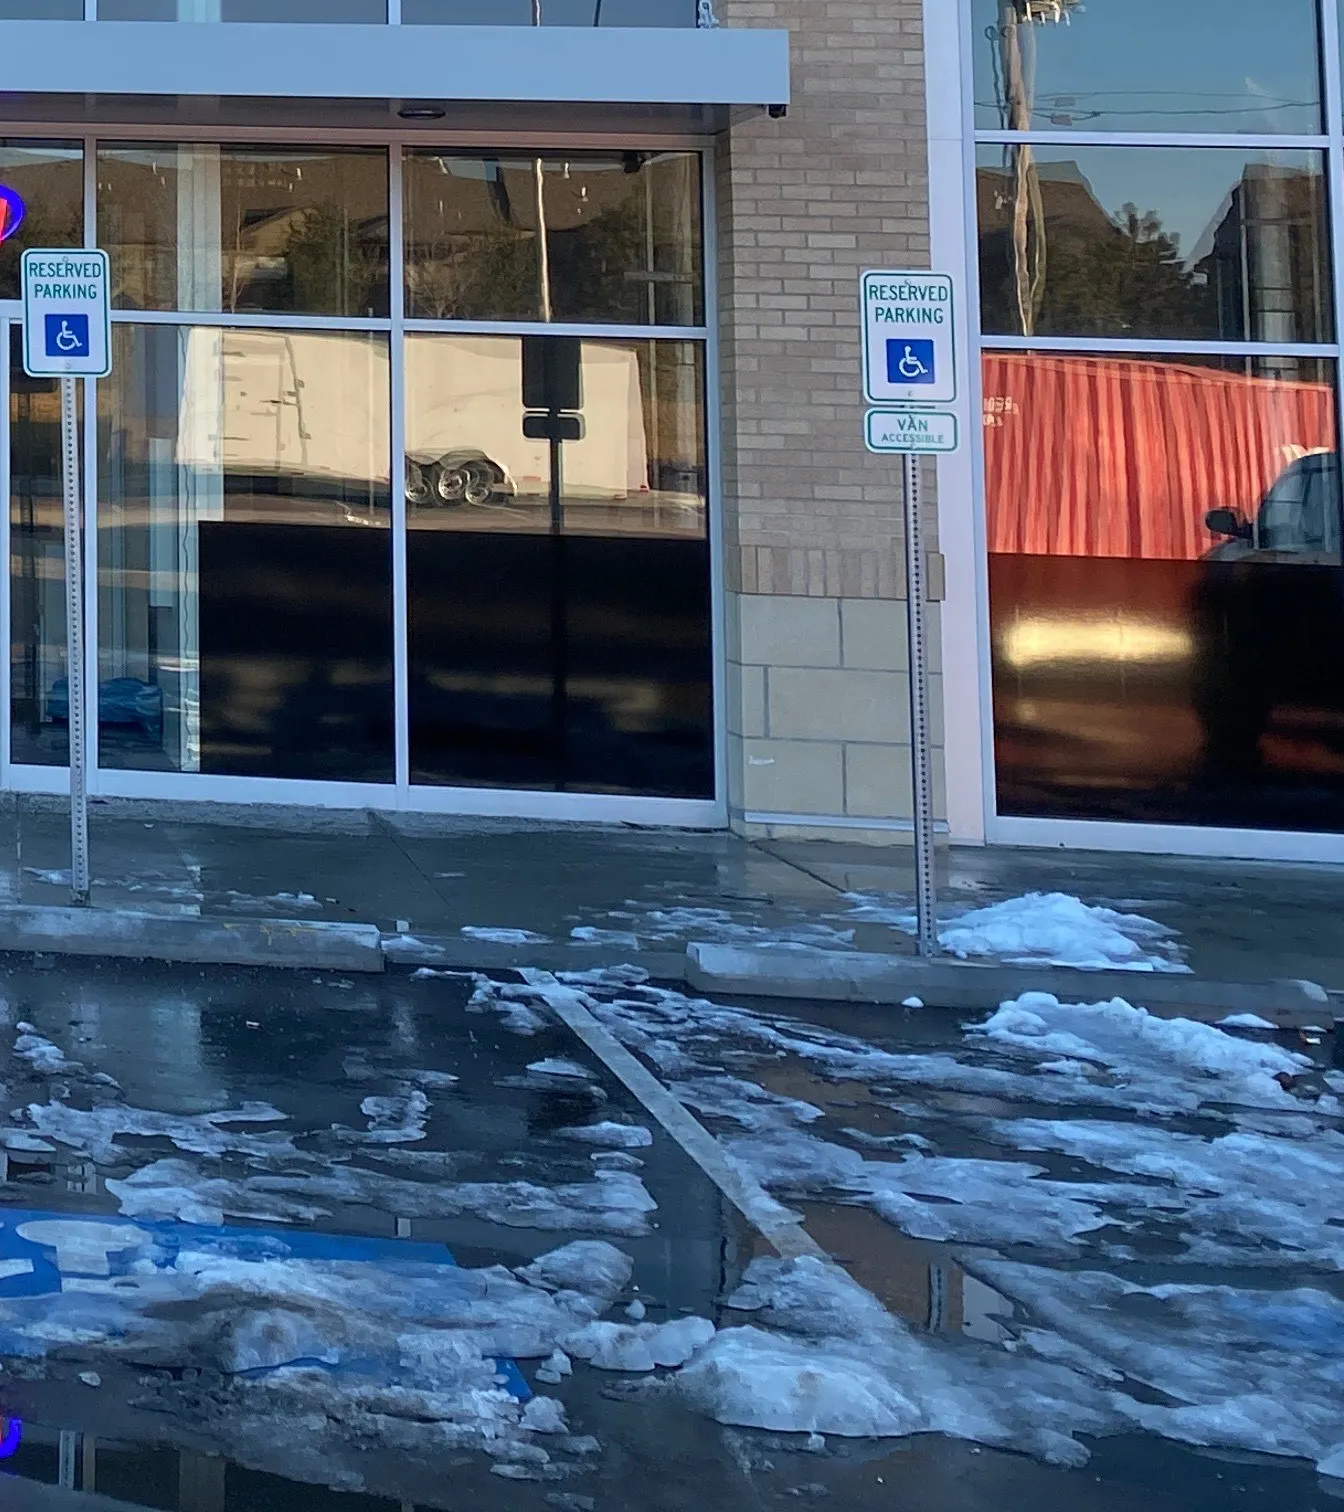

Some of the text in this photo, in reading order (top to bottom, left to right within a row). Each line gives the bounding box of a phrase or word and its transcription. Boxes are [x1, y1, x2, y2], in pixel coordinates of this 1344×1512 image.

[29, 262, 102, 278] RESERVED
[34, 283, 97, 299] PARKING
[869, 284, 948, 301] RESERVED
[875, 307, 944, 324] PARKING
[897, 418, 928, 432] VAN
[882, 433, 944, 444] ACCESSIBLE
